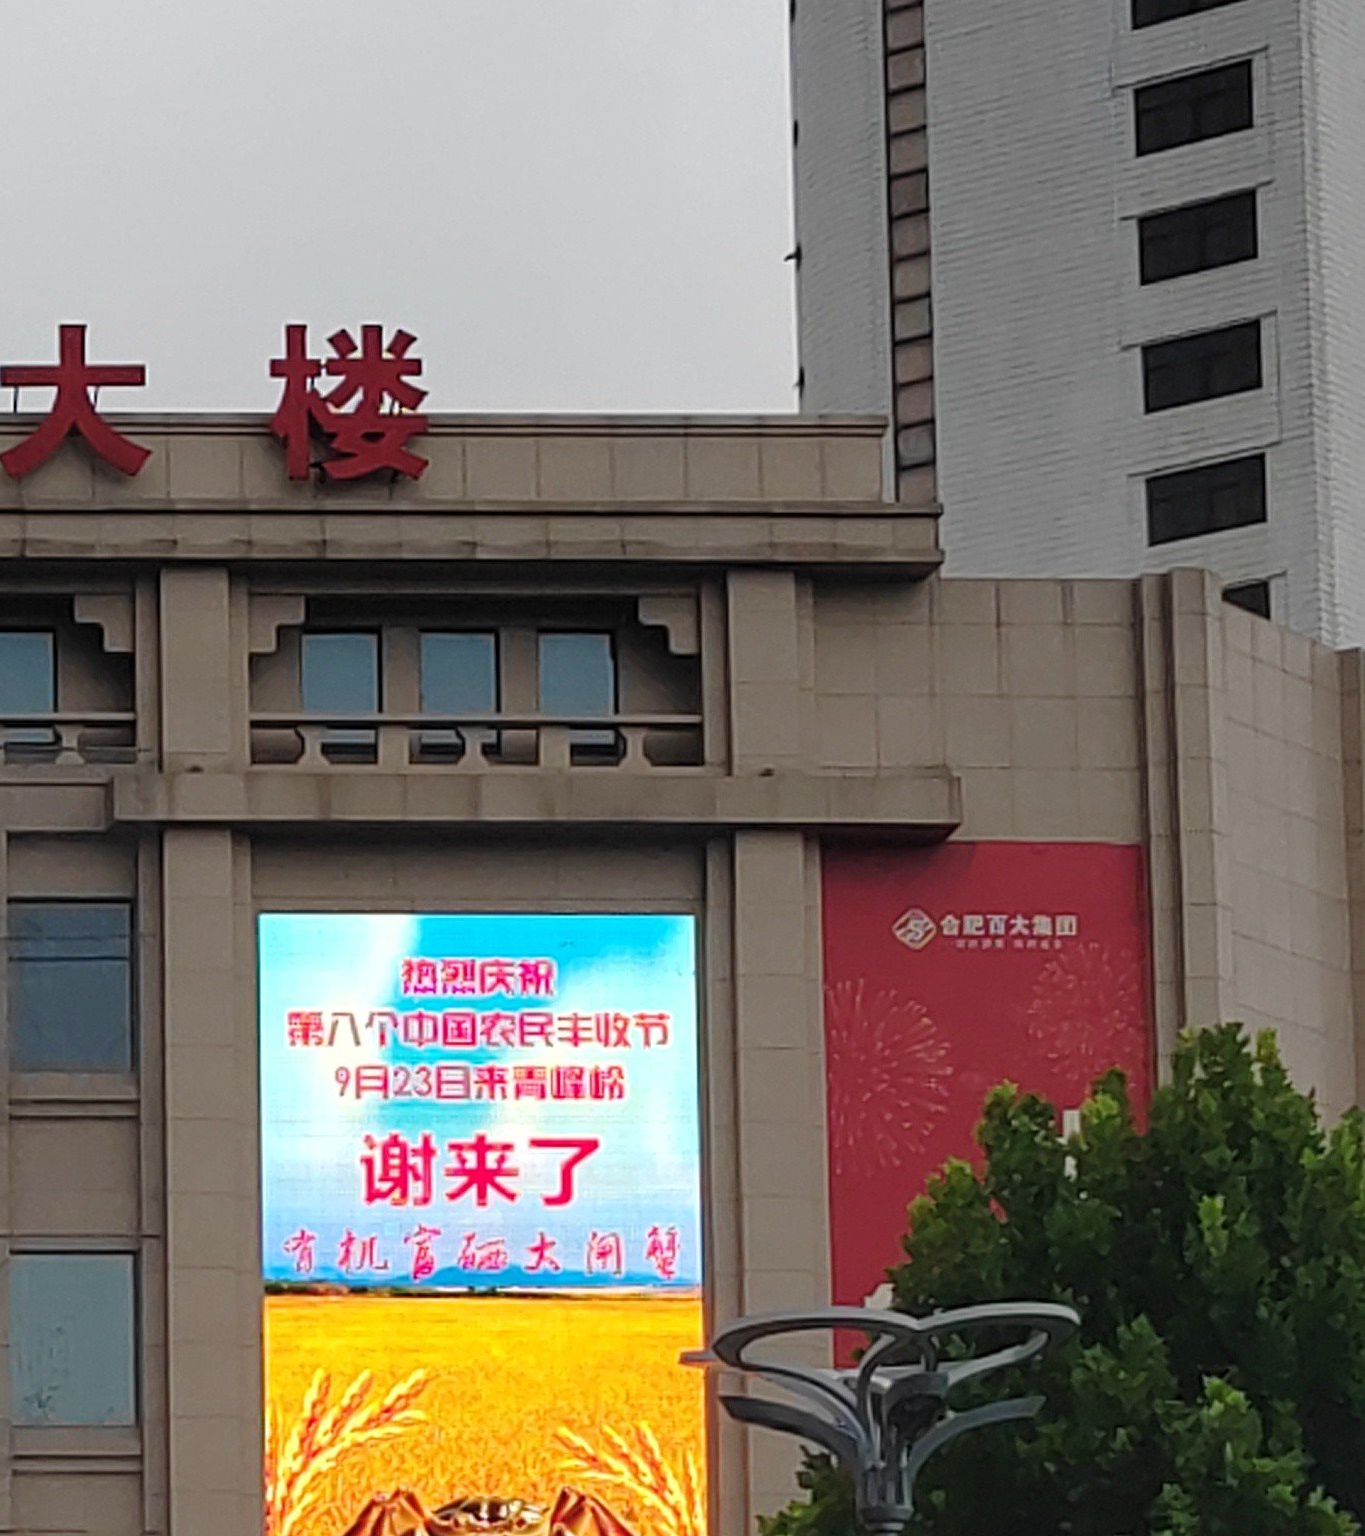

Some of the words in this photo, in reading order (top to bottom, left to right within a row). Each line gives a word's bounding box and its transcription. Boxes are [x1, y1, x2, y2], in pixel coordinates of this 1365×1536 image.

[940, 913, 1079, 937] 合肥百大集团
[400, 958, 556, 996] 热烈庆祝
[285, 1010, 671, 1049] 第八个中国农民丰收节
[359, 1132, 601, 1208] 谢来了
